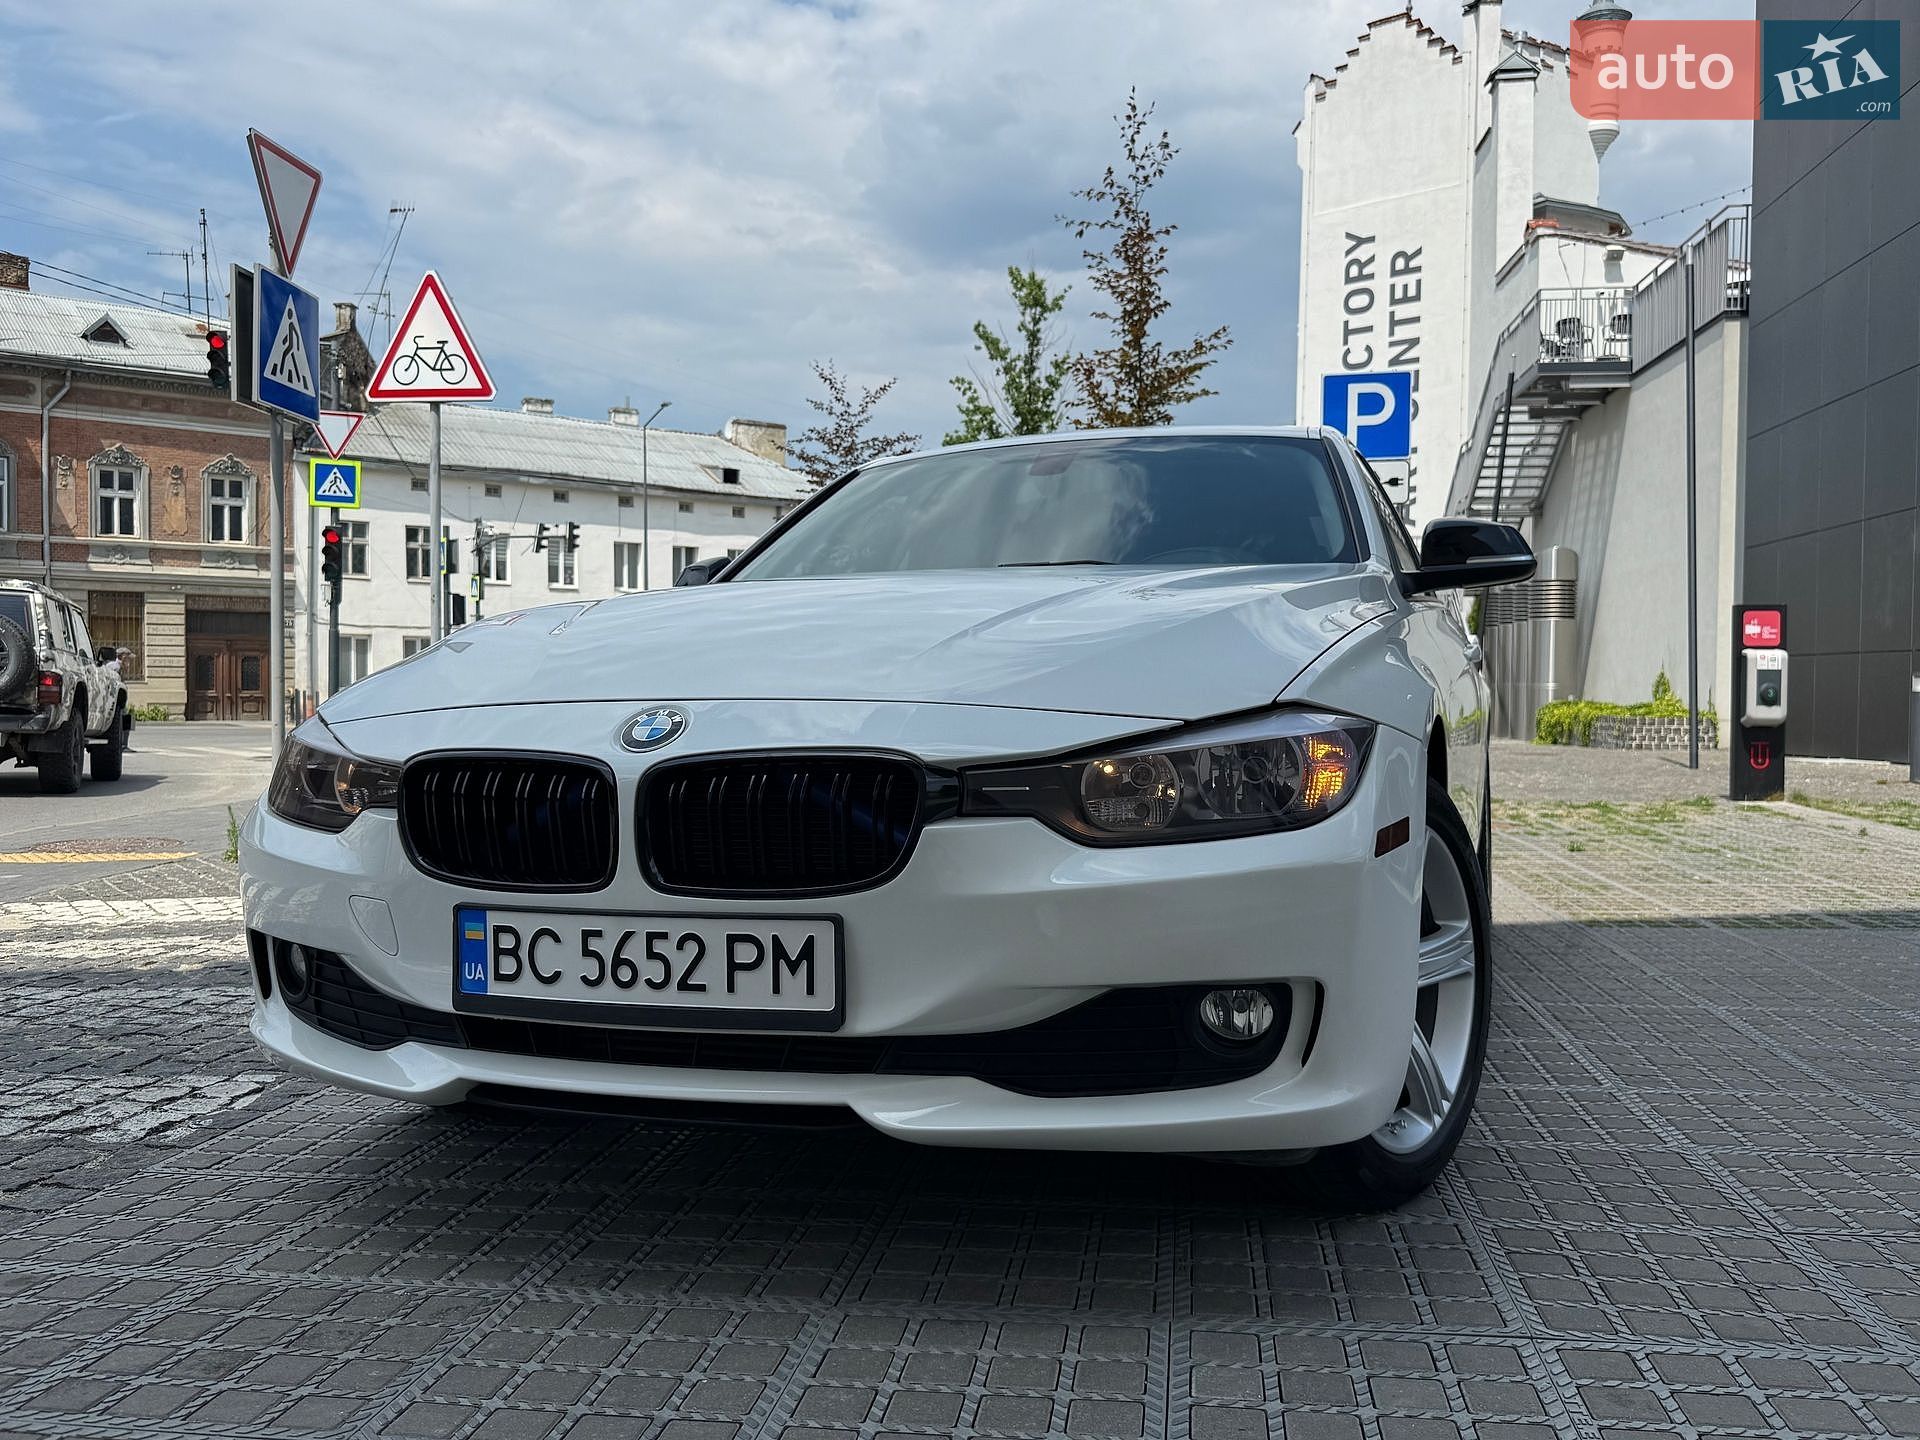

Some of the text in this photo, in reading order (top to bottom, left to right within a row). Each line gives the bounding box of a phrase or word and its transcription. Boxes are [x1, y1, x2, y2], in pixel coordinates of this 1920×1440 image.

[464, 962, 485, 981] UA
[492, 924, 815, 996] BC 5652 PM
